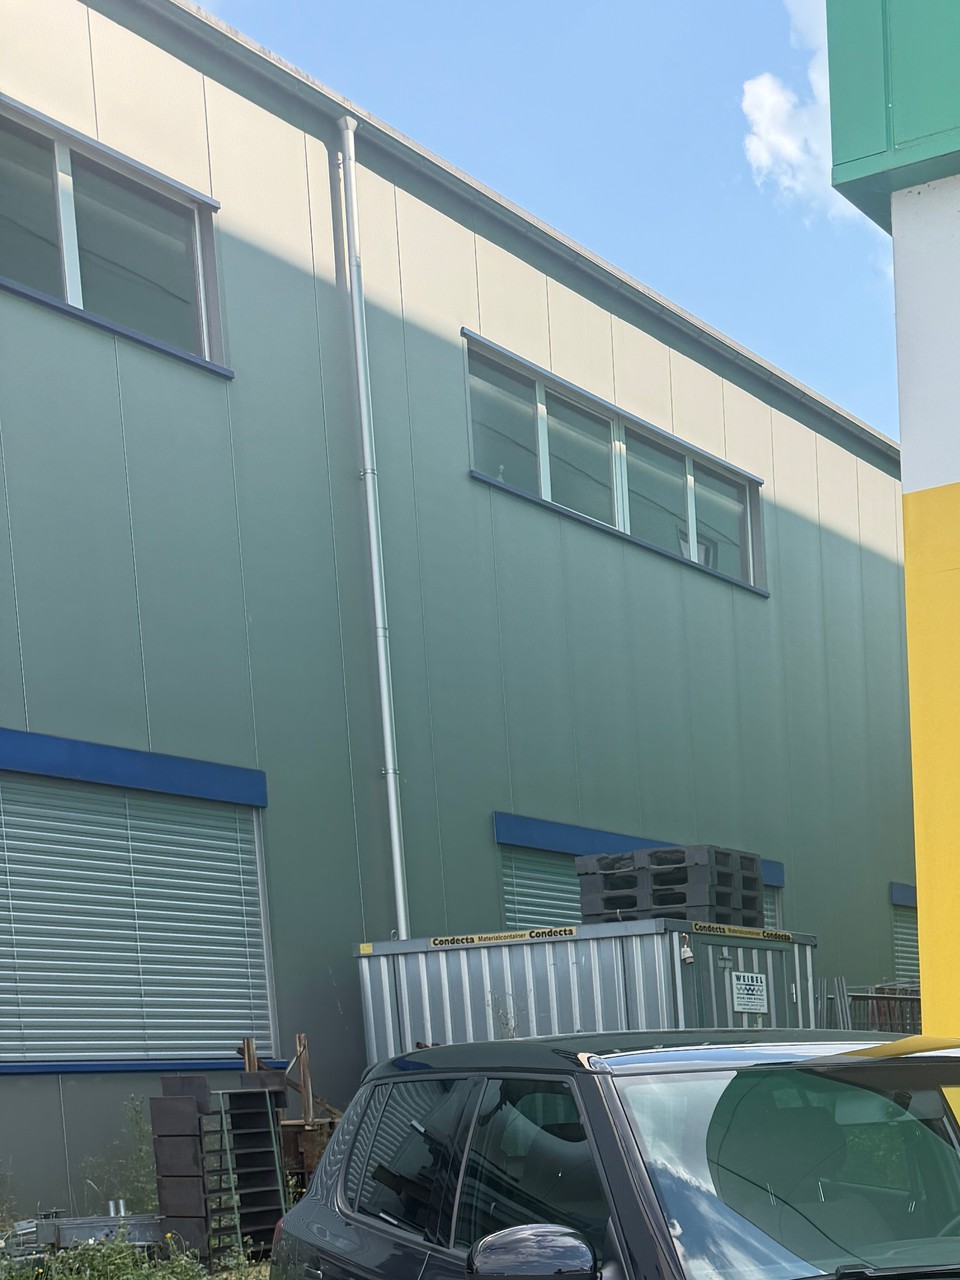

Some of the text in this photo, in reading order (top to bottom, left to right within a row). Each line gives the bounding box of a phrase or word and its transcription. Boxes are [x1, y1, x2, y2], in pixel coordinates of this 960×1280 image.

[433, 927, 574, 946] Condecta Materialcontainer Condecta
[694, 923, 726, 934] Condecta
[762, 930, 791, 941] Condecta
[735, 974, 763, 985] WEIBEL
